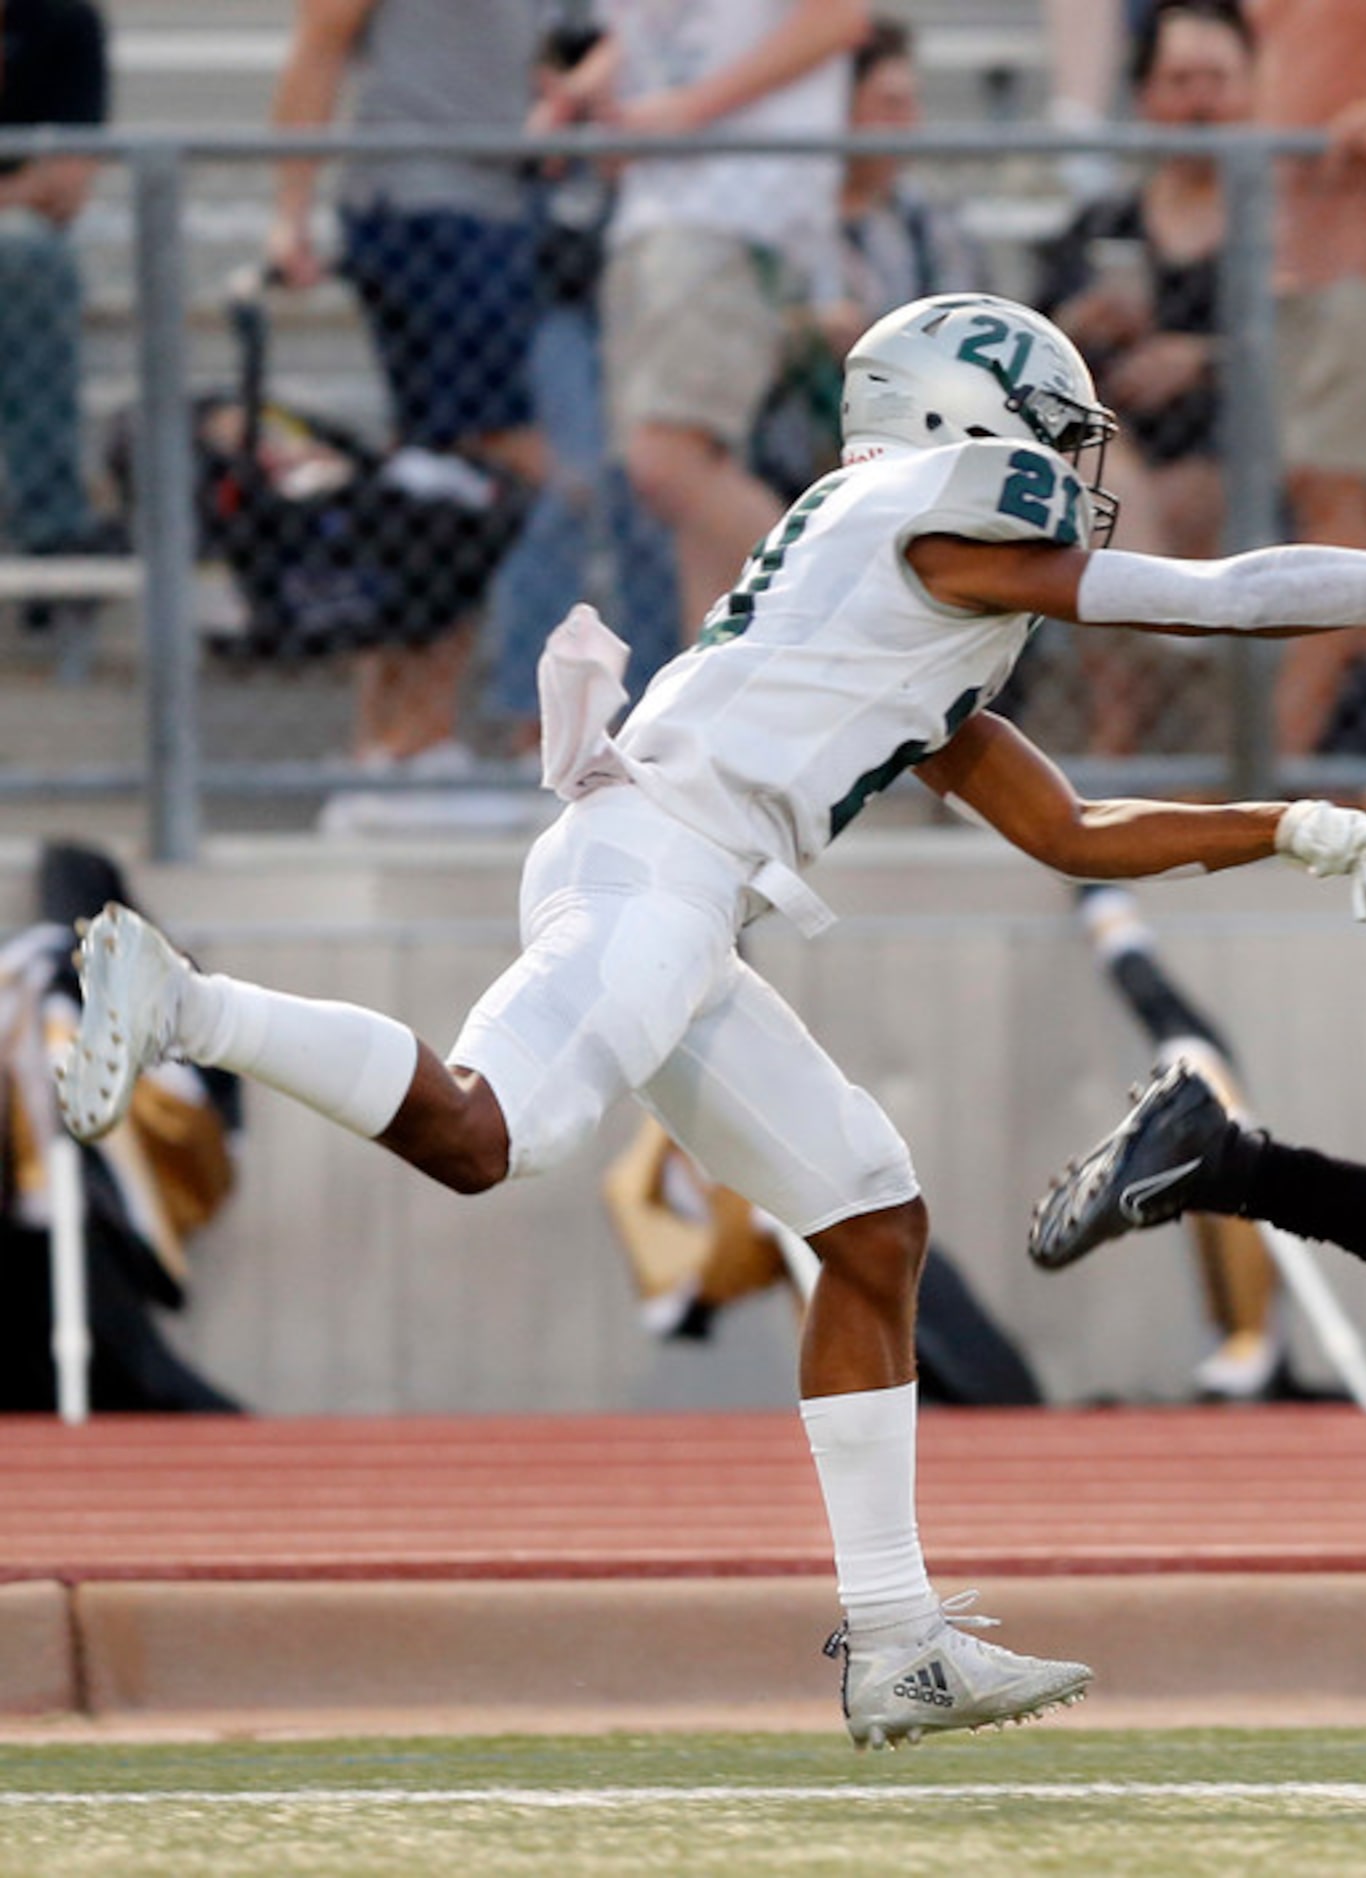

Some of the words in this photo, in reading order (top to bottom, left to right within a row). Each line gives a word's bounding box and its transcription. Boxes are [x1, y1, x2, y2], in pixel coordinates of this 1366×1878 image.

[956, 314, 1034, 385] 21
[996, 448, 1082, 543] 21
[893, 1683, 954, 1708] adidas
